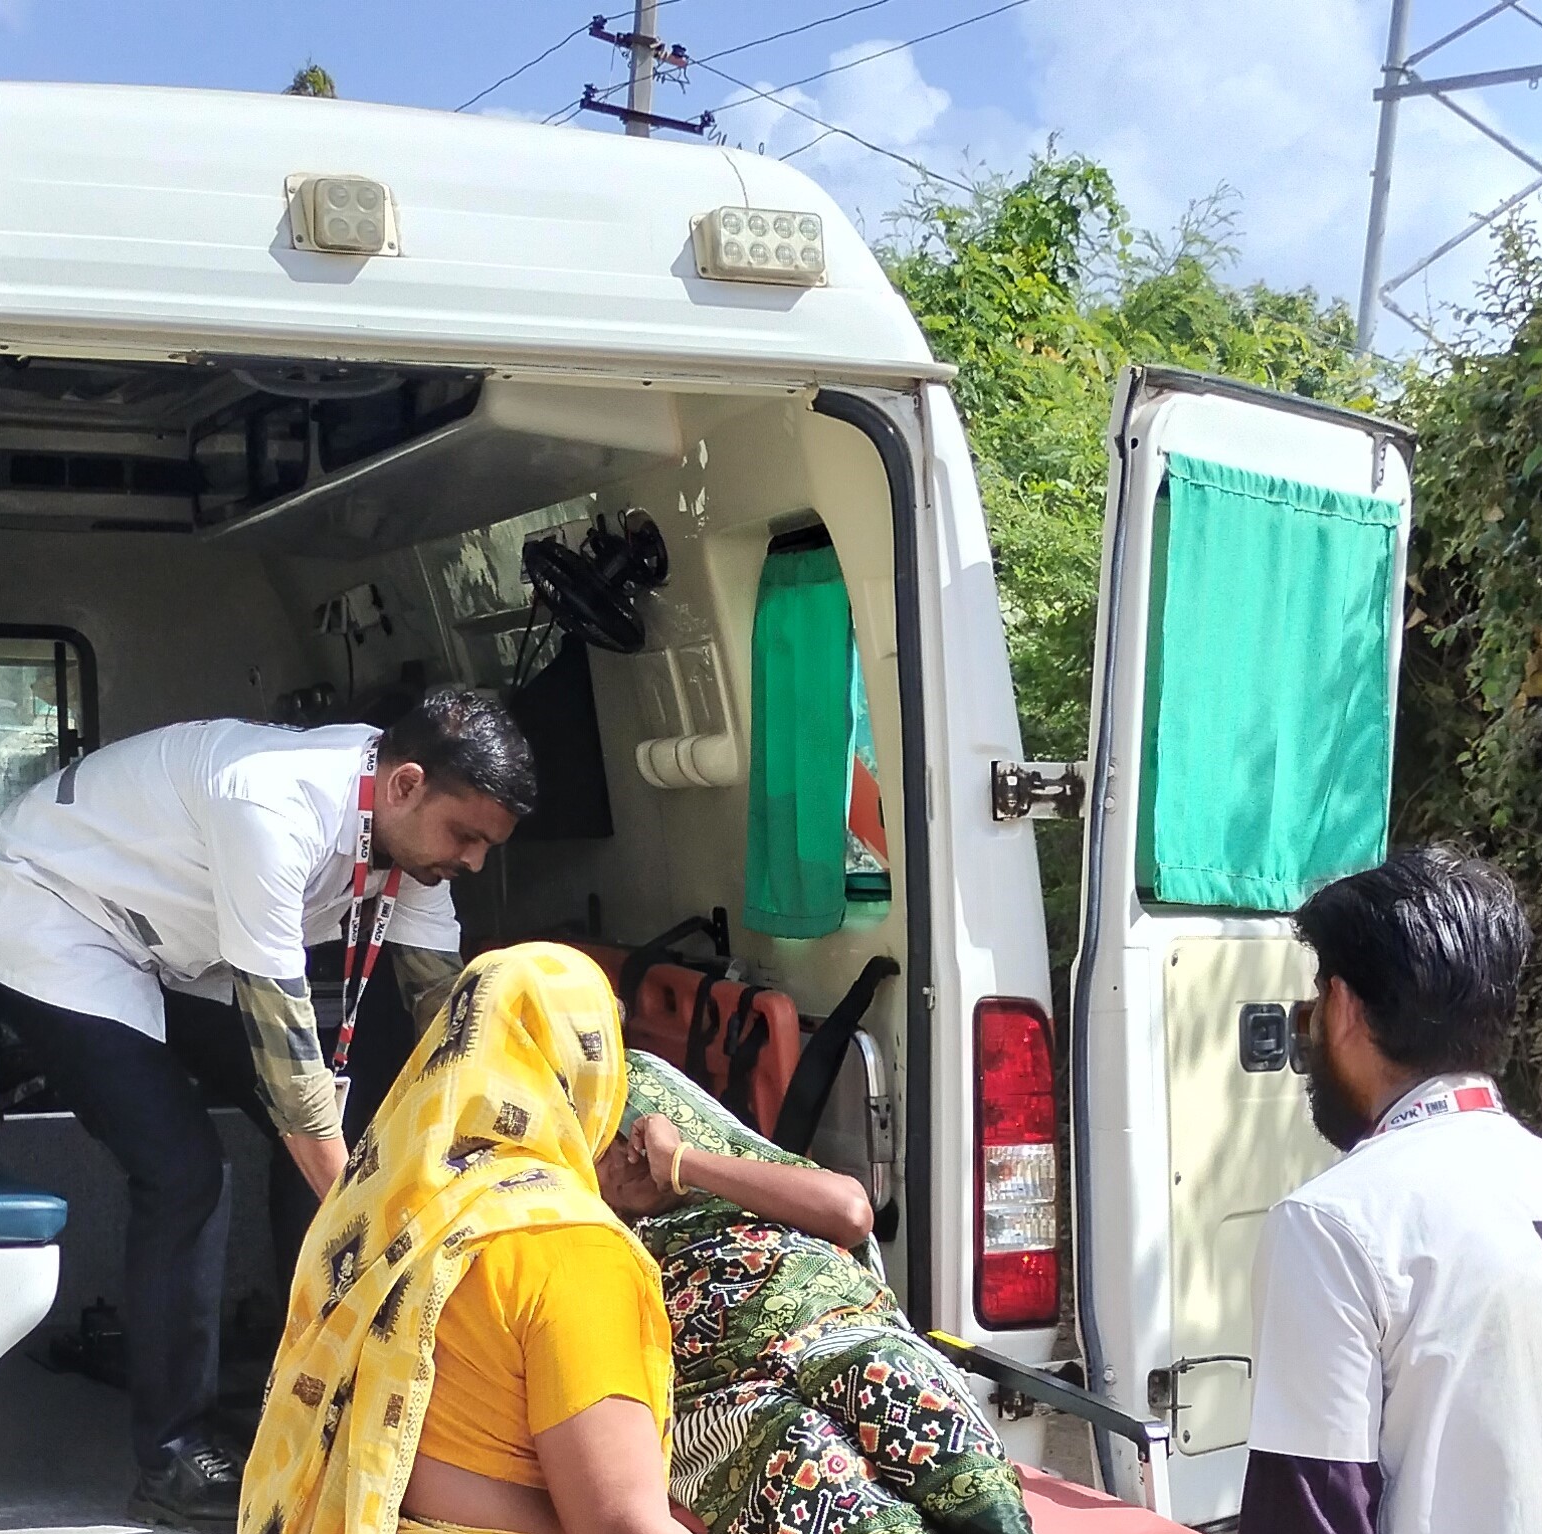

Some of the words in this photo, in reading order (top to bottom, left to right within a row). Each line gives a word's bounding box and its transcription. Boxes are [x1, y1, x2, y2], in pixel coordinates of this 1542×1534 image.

[361, 839, 370, 858] GVK
[374, 923, 386, 942] GVK
[1390, 1108, 1419, 1125] GVK
